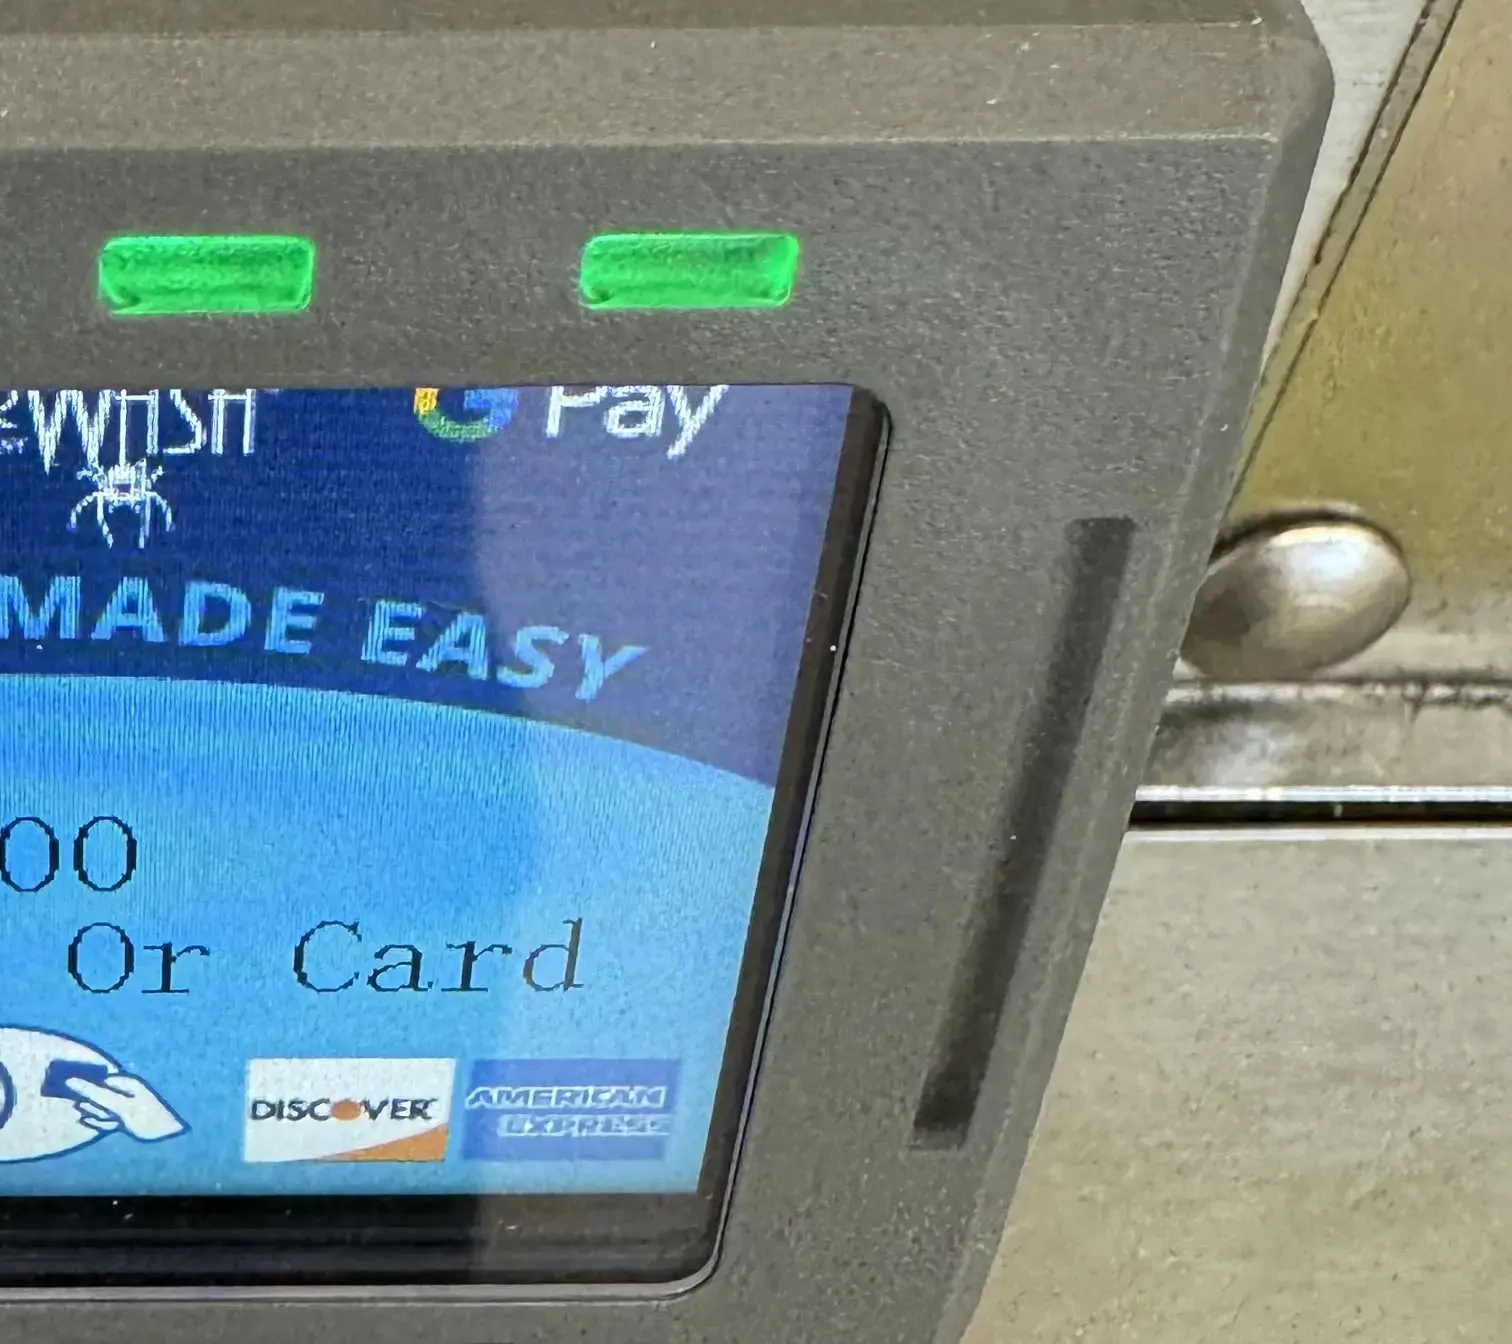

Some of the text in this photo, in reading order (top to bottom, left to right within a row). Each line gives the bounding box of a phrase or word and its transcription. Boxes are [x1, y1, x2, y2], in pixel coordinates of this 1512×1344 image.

[361, 599, 648, 703] EASY
[67, 921, 211, 995] Or
[292, 917, 584, 994] Card
[250, 1098, 437, 1122] DISCOVER
[465, 1085, 666, 1109] AMERICAN
